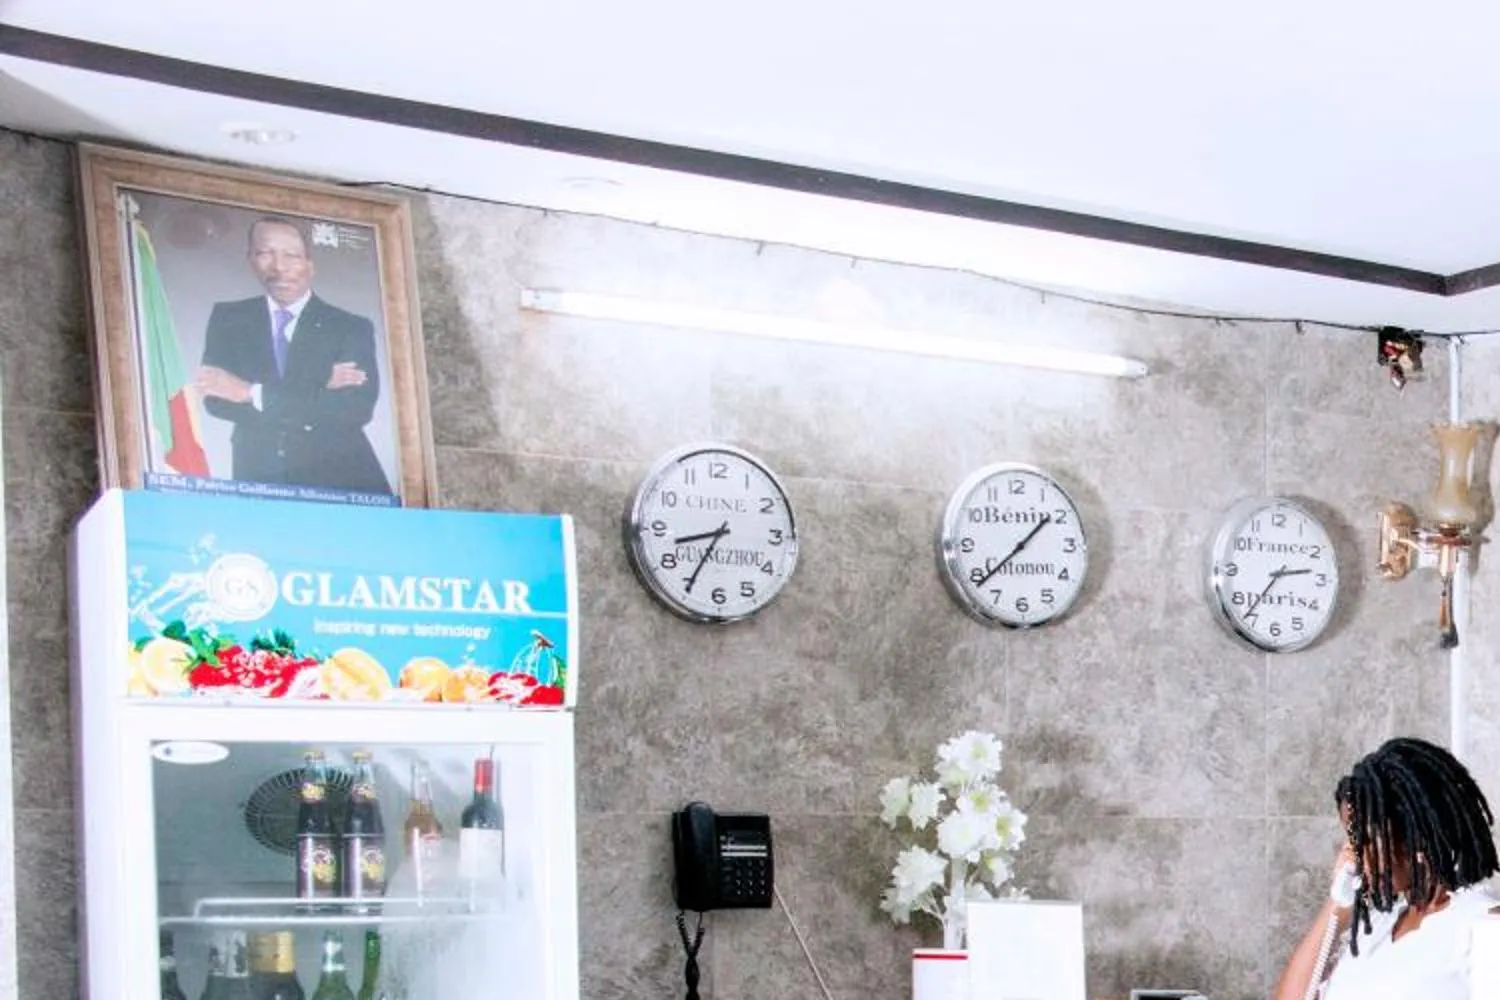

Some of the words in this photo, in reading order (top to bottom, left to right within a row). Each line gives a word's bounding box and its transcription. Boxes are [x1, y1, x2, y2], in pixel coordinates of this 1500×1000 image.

[709, 462, 728, 479] 12
[1008, 479, 1025, 494] 12
[661, 491, 677, 508] 10
[686, 495, 747, 513] CHINE
[760, 498, 775, 514] 2
[968, 507, 983, 523] 10
[1055, 509, 1067, 524] 2
[1271, 513, 1287, 528] 12
[767, 528, 783, 546] 3
[1233, 537, 1246, 551] 10
[1063, 538, 1076, 553] 3
[1309, 545, 1321, 559] 2
[661, 553, 677, 569] 8
[760, 561, 774, 576] 4
[1057, 567, 1069, 580] 4
[1315, 573, 1327, 587] 3
[281, 571, 532, 613] GLAMSTAR
[711, 588, 727, 604] 6
[740, 581, 755, 597] 5
[990, 589, 1002, 604] 7
[1041, 589, 1054, 604] 5
[1015, 597, 1029, 612] 6
[1231, 591, 1245, 605] 8
[1269, 622, 1281, 637] 6
[1291, 617, 1303, 631] 5
